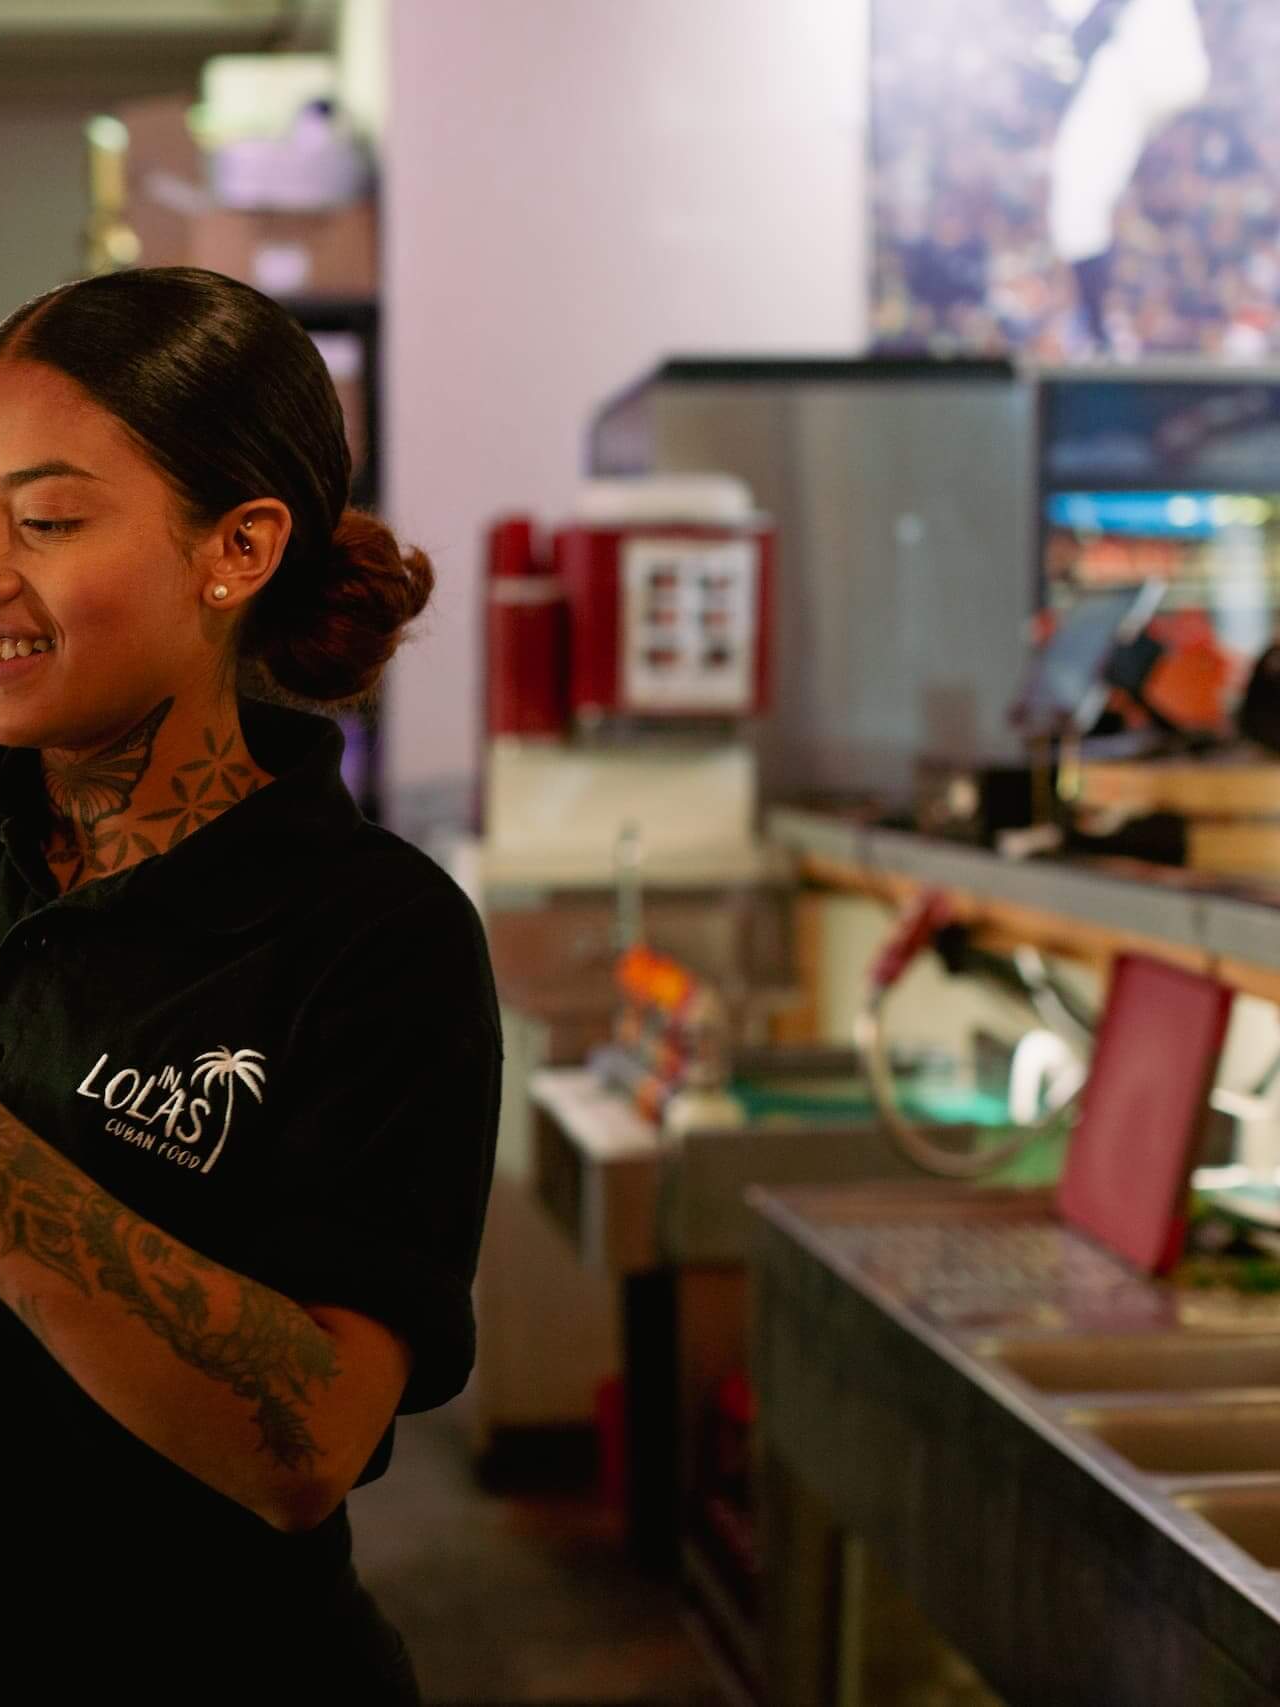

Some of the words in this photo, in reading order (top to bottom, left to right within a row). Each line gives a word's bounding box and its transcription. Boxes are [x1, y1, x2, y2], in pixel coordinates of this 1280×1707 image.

[77, 1053, 211, 1143] LOLAS
[157, 1065, 183, 1093] IN
[105, 1118, 156, 1151] CUBAN
[158, 1142, 200, 1169] FOOD
